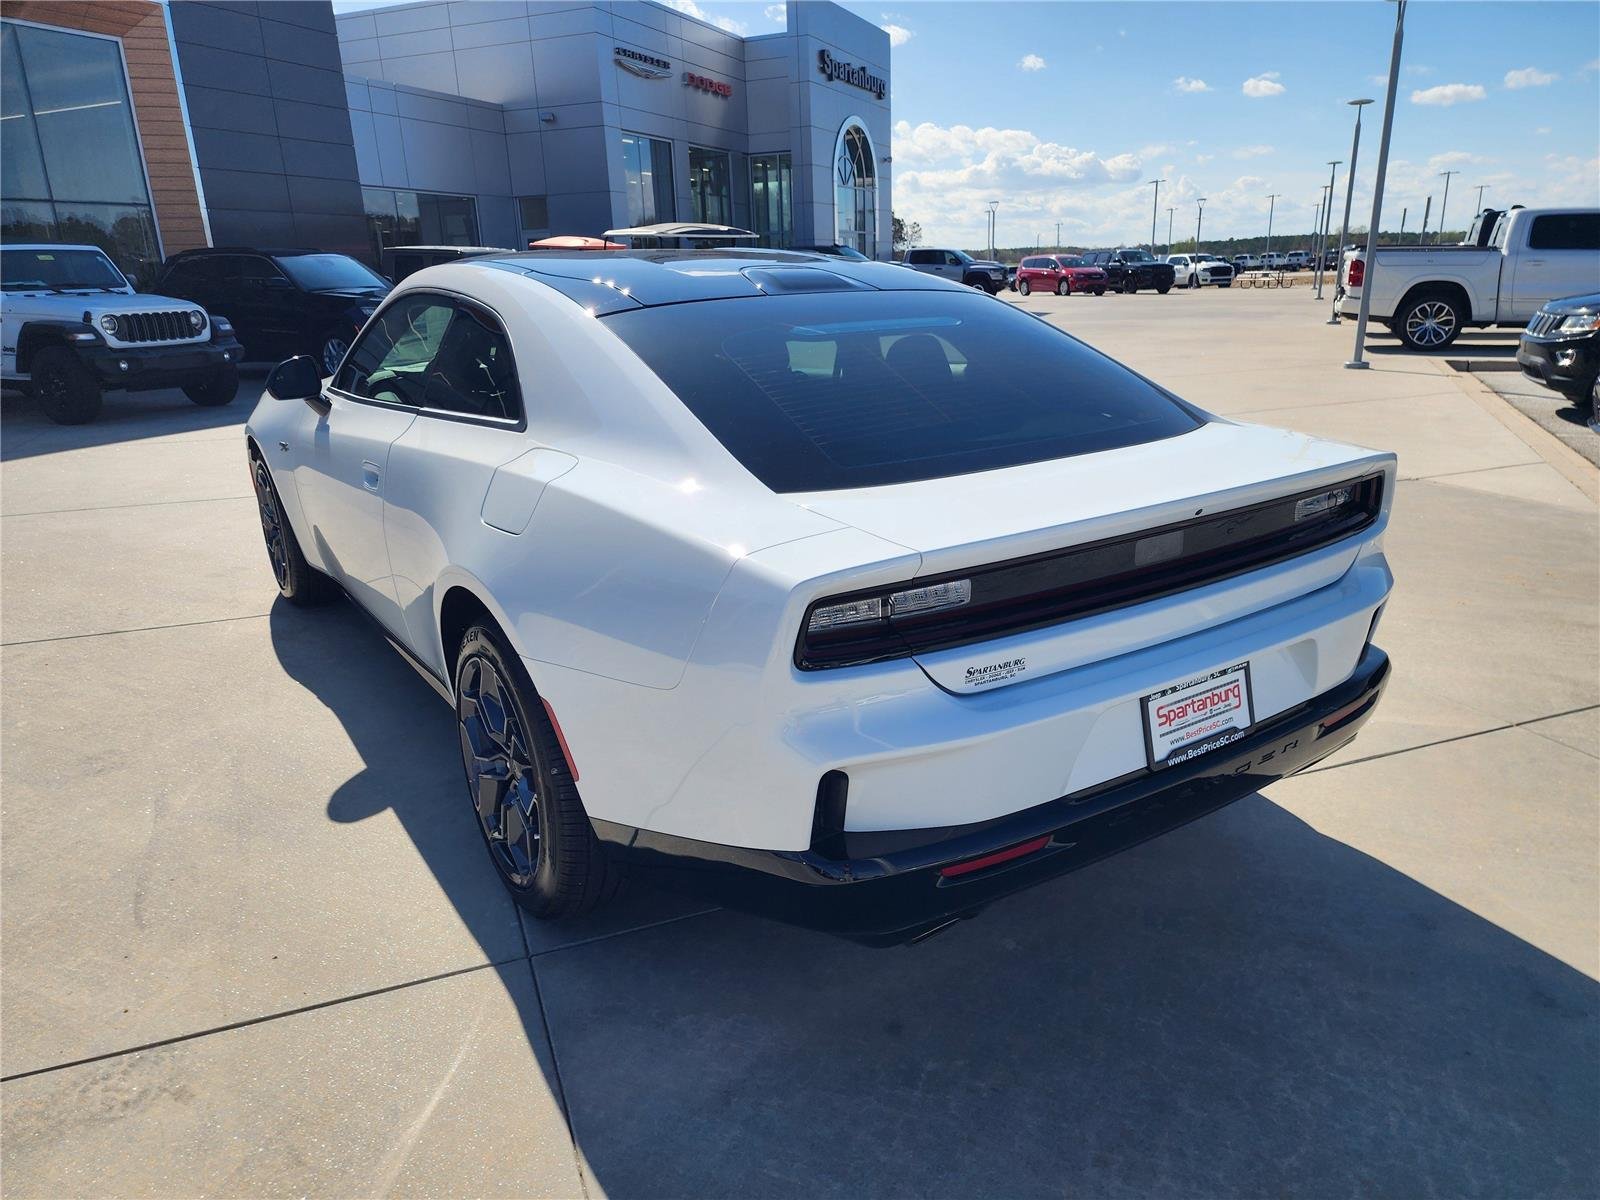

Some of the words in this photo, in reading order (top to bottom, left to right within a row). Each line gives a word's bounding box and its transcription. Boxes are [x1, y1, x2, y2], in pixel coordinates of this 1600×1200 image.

[685, 72, 733, 97] DODGE
[818, 49, 887, 100] Spartanburg
[965, 658, 1026, 678] SPARTANBURG
[1156, 684, 1242, 727] Spartanburg
[1169, 716, 1234, 746] www.BestPriceSC.com
[1167, 731, 1245, 767] www.BestPriceSC.com
